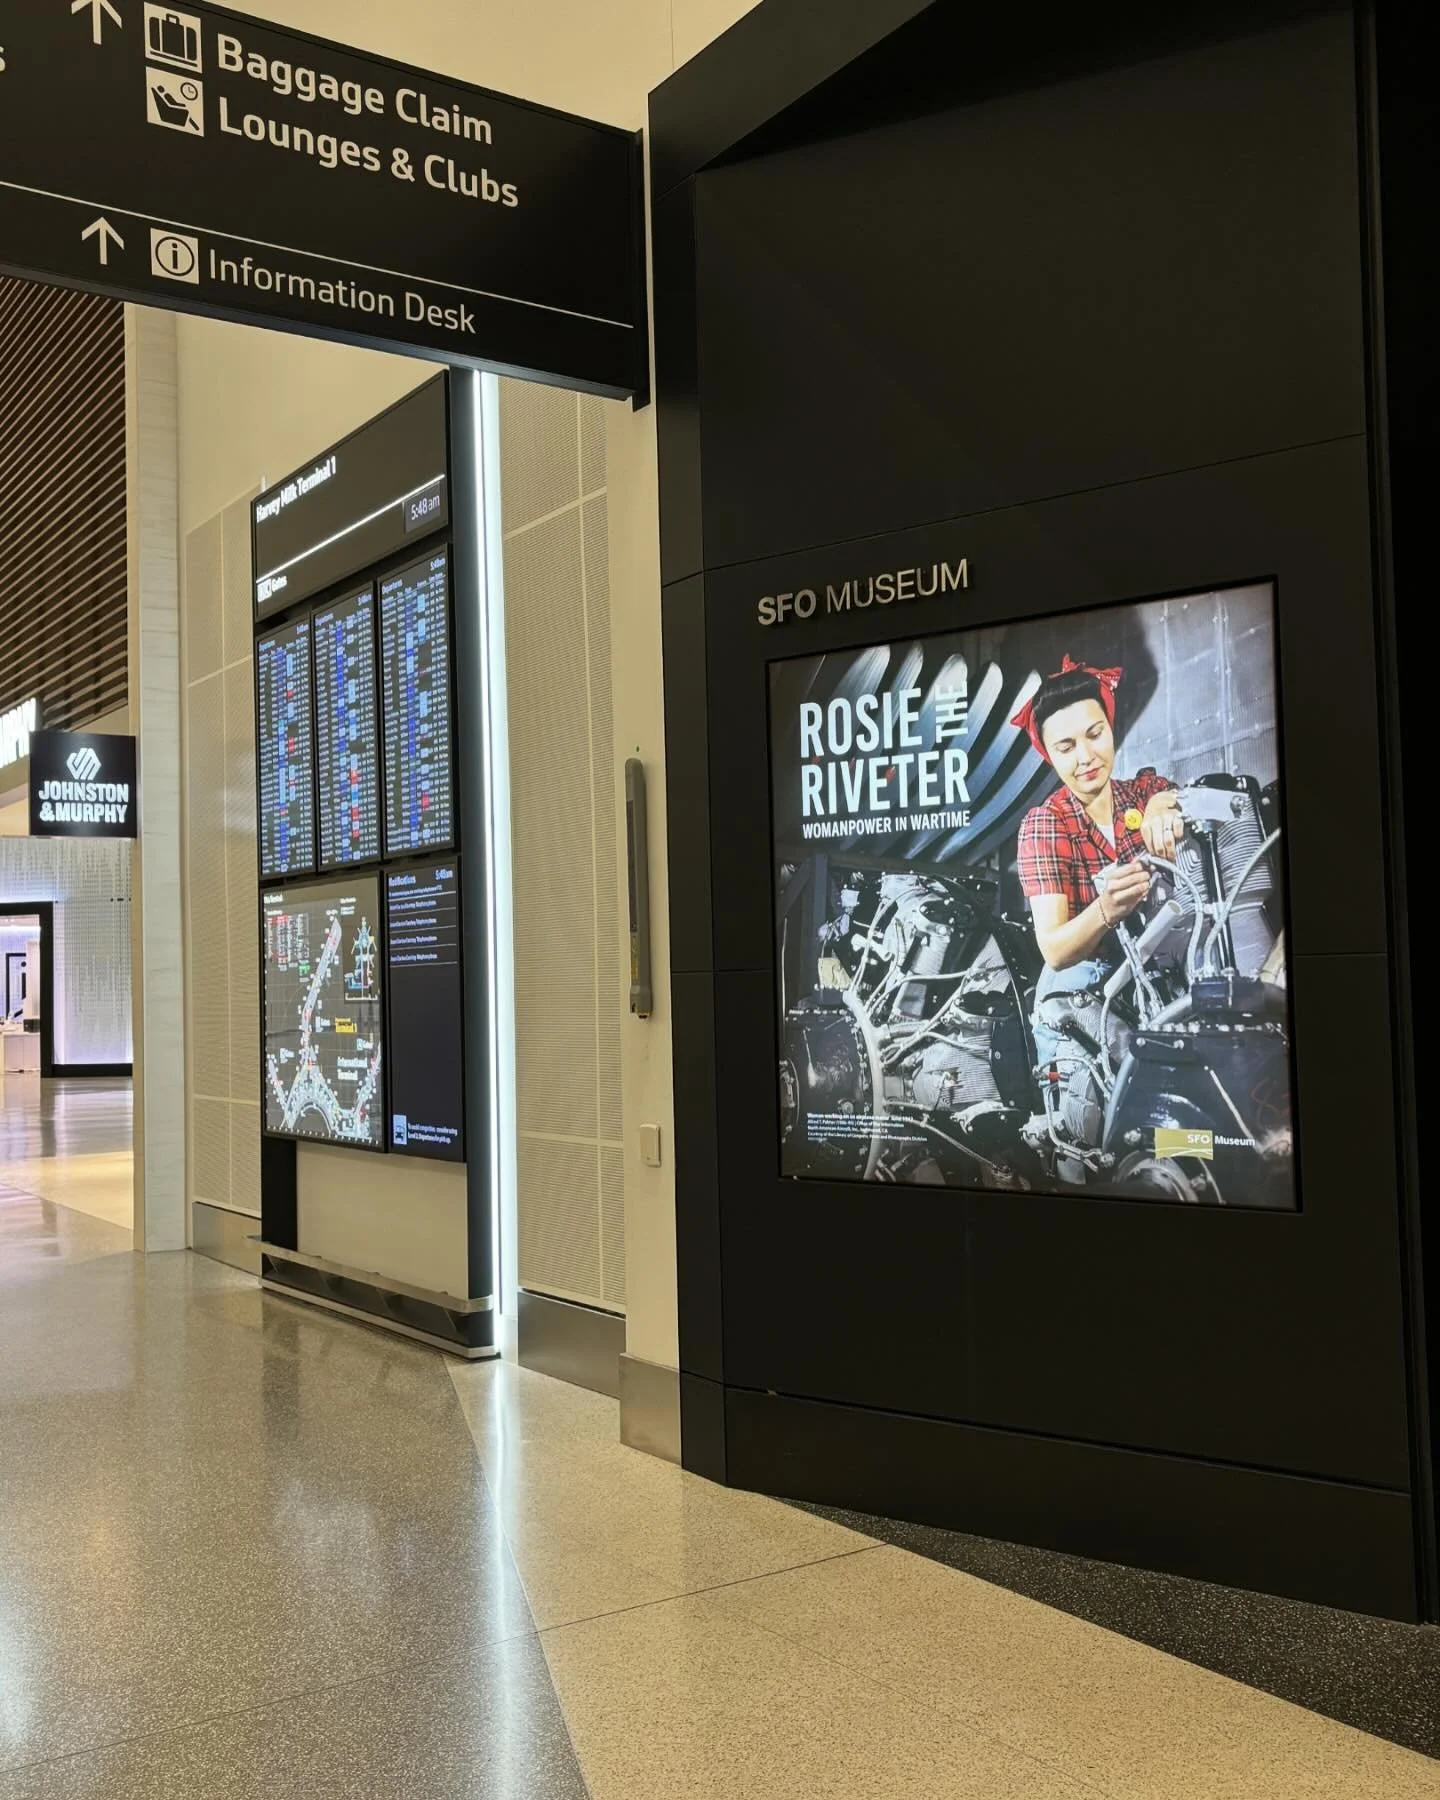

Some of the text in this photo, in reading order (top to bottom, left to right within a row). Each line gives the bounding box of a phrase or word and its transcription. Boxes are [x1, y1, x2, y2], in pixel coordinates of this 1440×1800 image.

[218, 32, 493, 144] Baggage Claim
[219, 96, 518, 208] Lounges & Clubs
[211, 249, 477, 333] Information Desk
[256, 499, 281, 523] Harvey
[297, 459, 331, 496] Terminal
[758, 558, 970, 625] SFO MUSEUM
[800, 687, 922, 757] ROSIE
[935, 681, 969, 742] THE
[39, 781, 128, 802] JOHNSTON
[802, 749, 970, 817] RIVETER
[802, 811, 970, 840] WOMANPOWER IN WARTIME
[1187, 1134, 1255, 1147] SFO Museum
